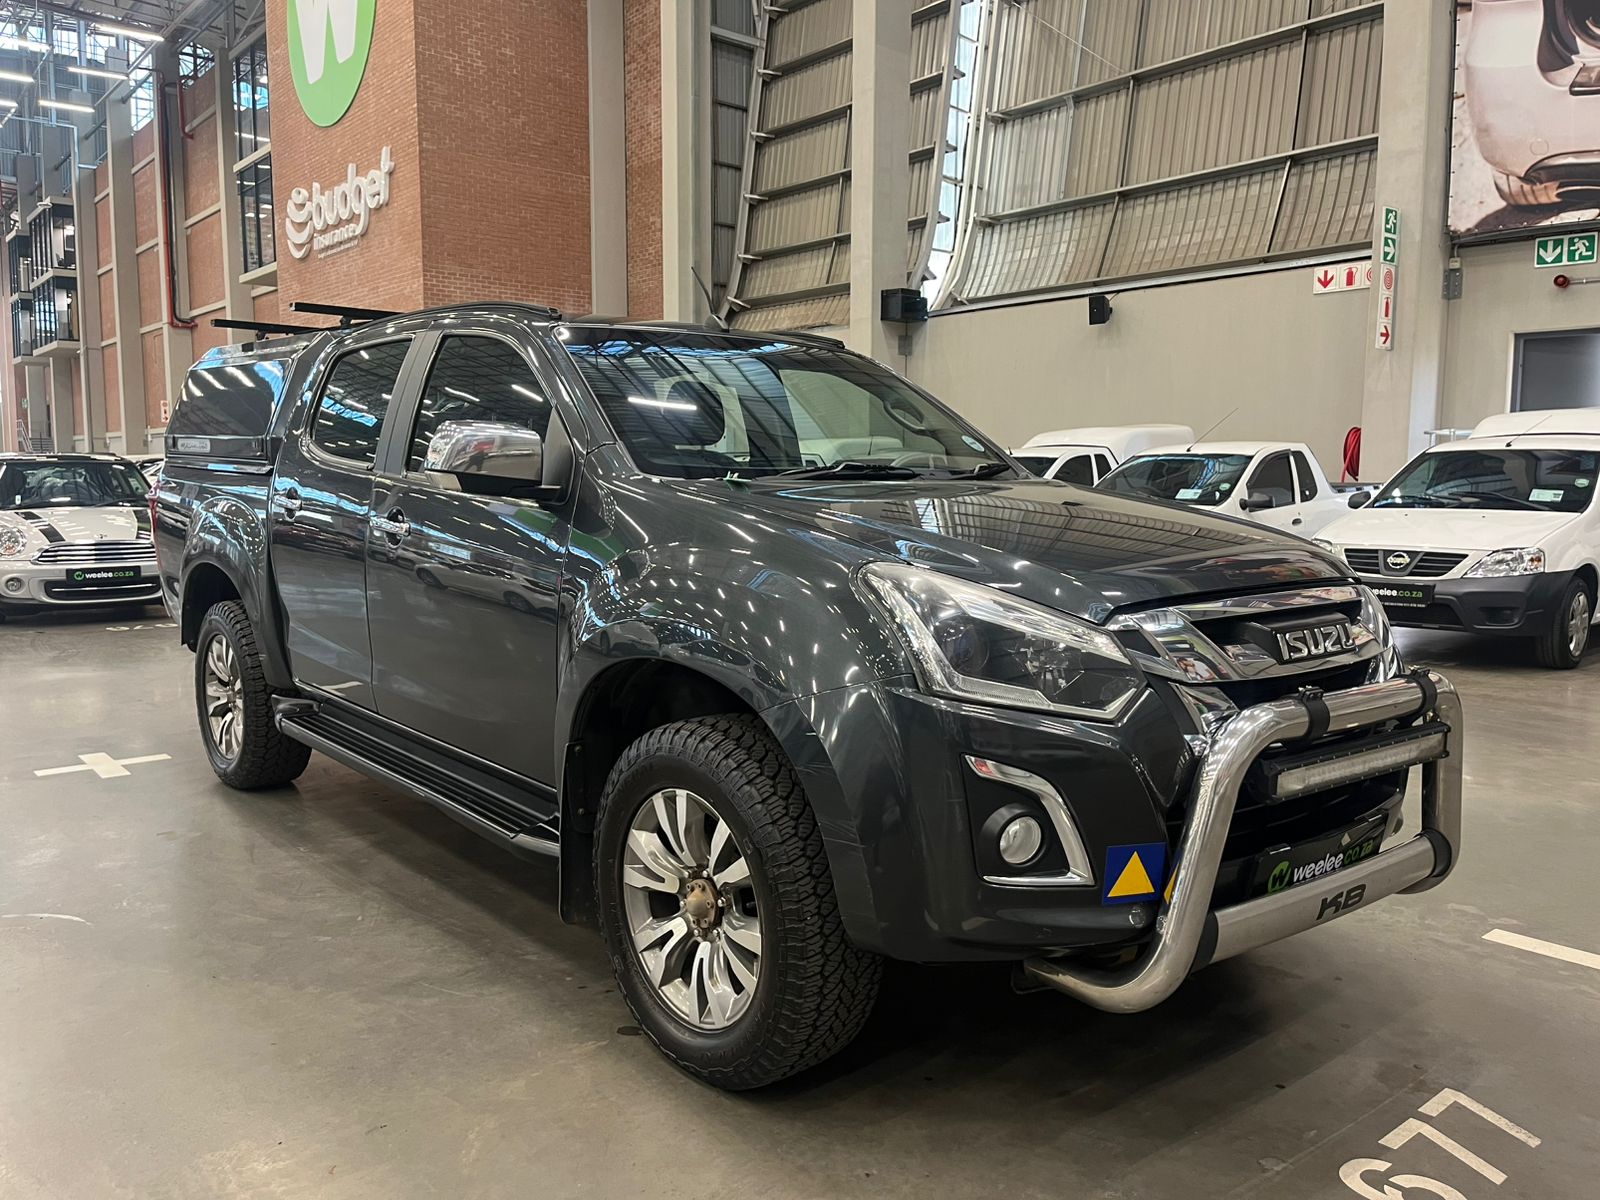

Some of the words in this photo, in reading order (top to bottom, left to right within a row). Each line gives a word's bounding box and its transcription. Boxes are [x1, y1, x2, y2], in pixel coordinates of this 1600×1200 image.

[312, 146, 395, 237] budget
[85, 571, 134, 579] weelee.co.za
[1372, 587, 1423, 598] eelee.co.za
[1276, 623, 1356, 660] ISUZU
[1315, 884, 1367, 920] KB
